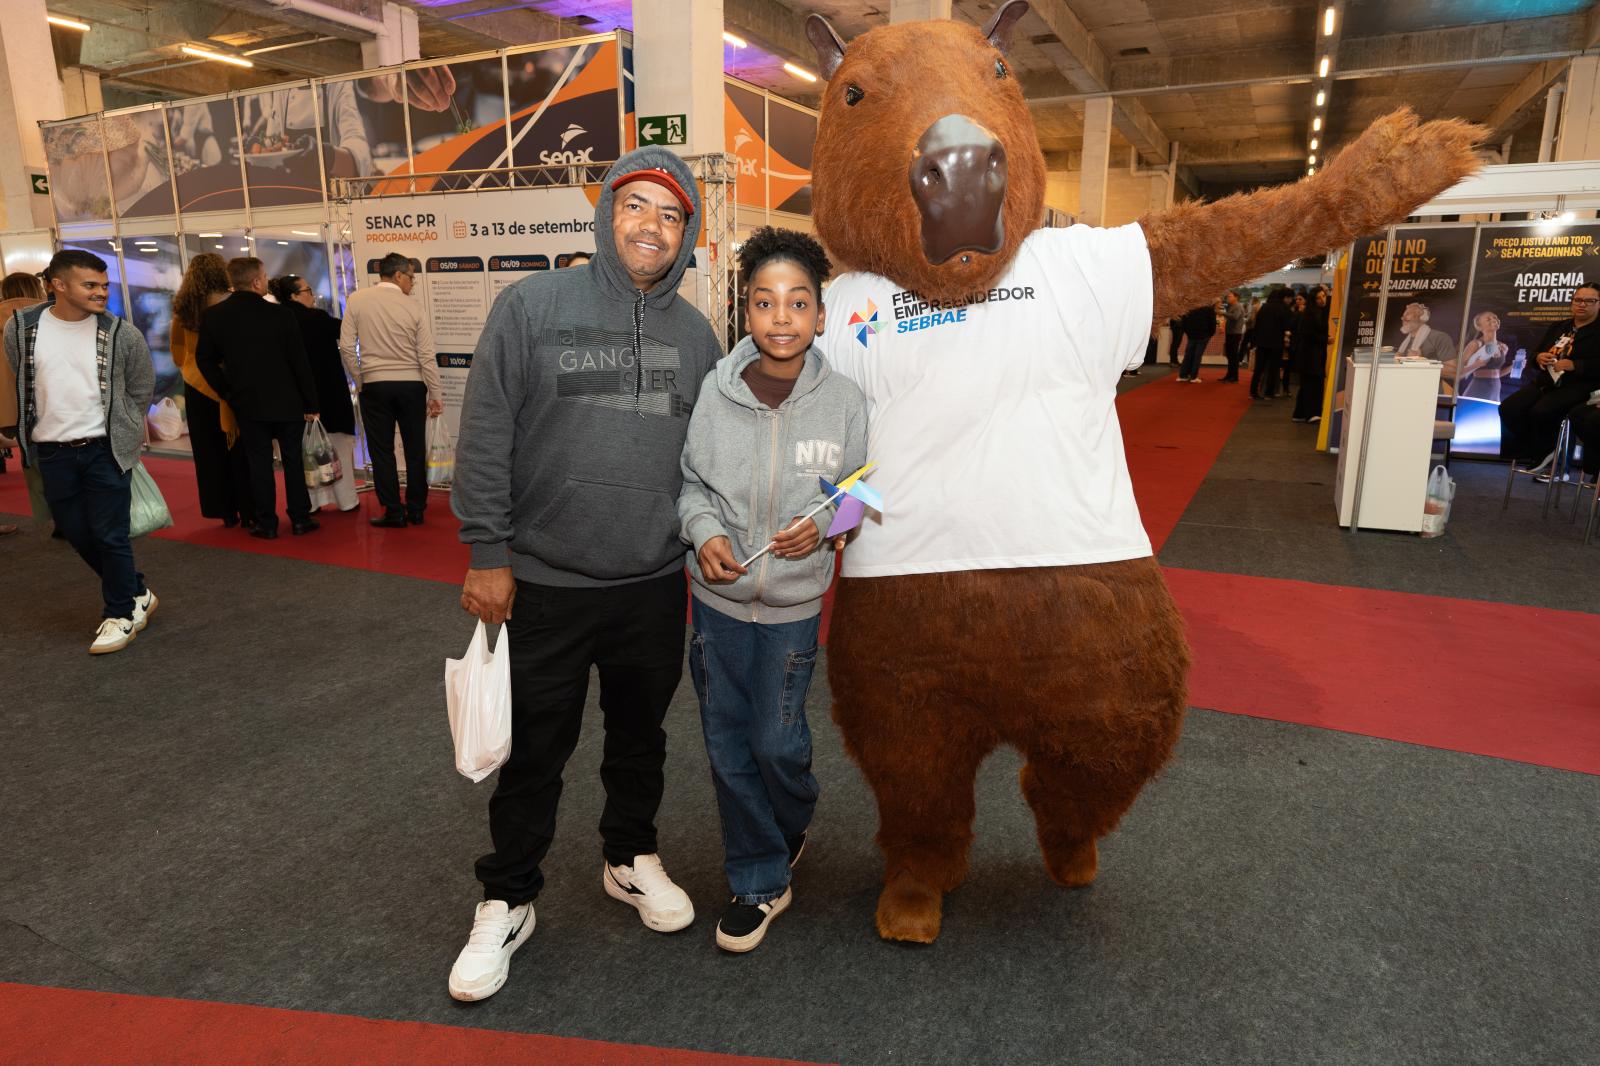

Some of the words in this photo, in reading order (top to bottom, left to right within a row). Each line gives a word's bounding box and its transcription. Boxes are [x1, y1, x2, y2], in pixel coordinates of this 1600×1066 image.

[736, 157, 758, 178] nac
[365, 214, 413, 230] SENAC
[417, 213, 436, 228] PR
[470, 223, 478, 236] 3
[481, 225, 489, 236] a
[492, 222, 505, 235] 13
[508, 221, 526, 235] de
[366, 229, 438, 243] PROGRAMAÇÃO
[1493, 238, 1519, 247] PREÇO
[1520, 237, 1543, 246] JUSTO
[1551, 237, 1569, 245] ANO
[1570, 236, 1594, 245] TODO,
[1367, 239, 1401, 257] AQI
[1405, 239, 1427, 255] NO
[1500, 248, 1521, 258] SEM
[1522, 246, 1583, 258] PEGADINHAS
[440, 262, 458, 270] 05/09
[501, 260, 520, 269] 06/09
[1365, 258, 1421, 274] OULET
[1379, 279, 1429, 290] CADEMIA
[1430, 278, 1457, 289] SESC
[1514, 272, 1585, 287] ACADEMIA
[1518, 289, 1527, 303] E
[1529, 288, 1577, 303] PILATE
[897, 309, 967, 334] SEBRAE
[449, 357, 466, 366] 10/09
[559, 347, 635, 371] GANG
[795, 439, 841, 468] NYC
